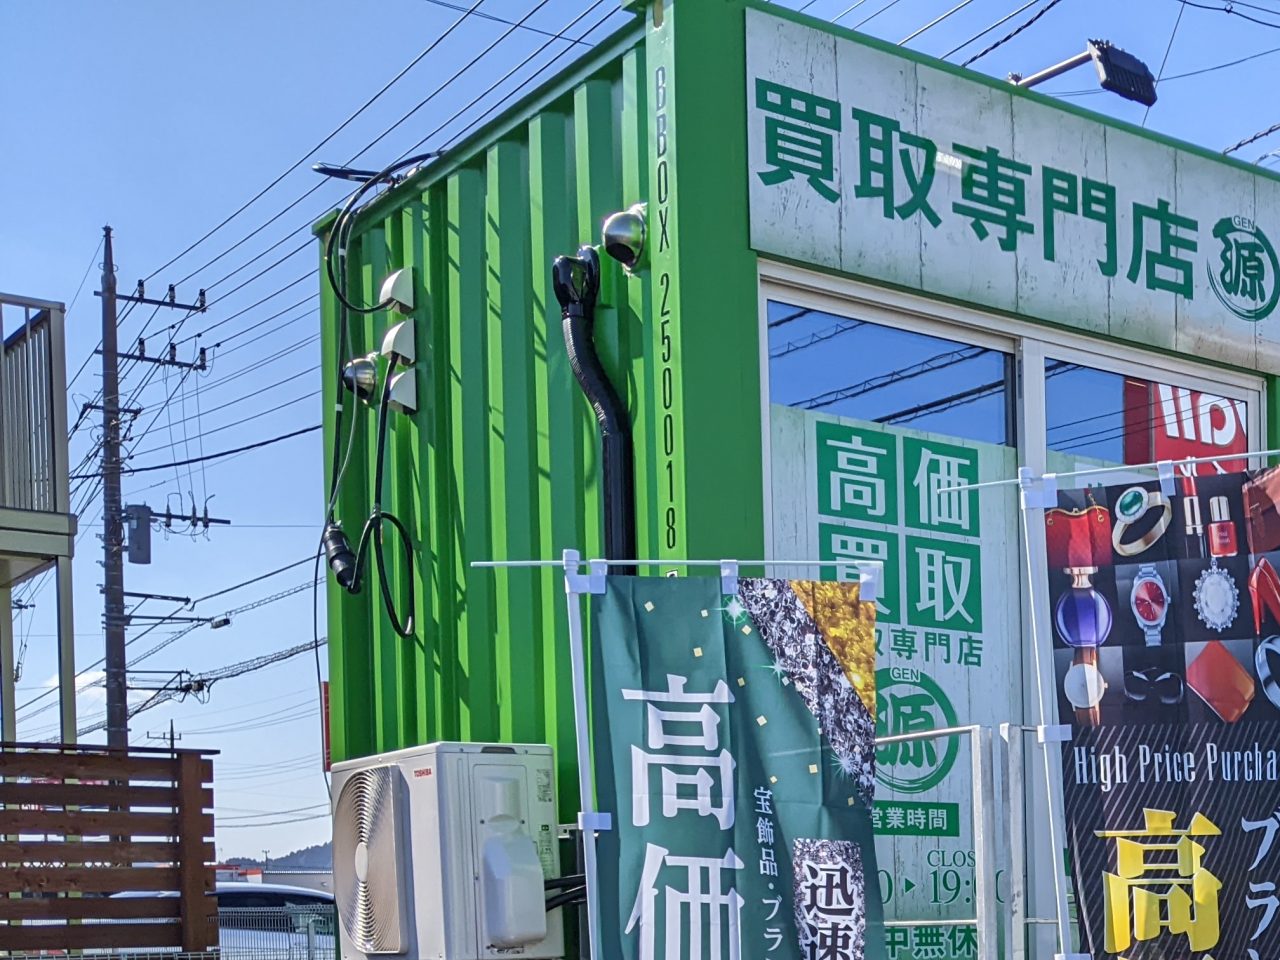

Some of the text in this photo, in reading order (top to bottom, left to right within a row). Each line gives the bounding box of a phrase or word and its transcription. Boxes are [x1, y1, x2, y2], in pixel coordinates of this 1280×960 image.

[654, 66, 671, 254] BBOX
[754, 78, 1266, 303] 買取専門店 源
[1232, 214, 1256, 230] GEN
[660, 272, 677, 549] 250018
[825, 434, 971, 531] 高価
[891, 666, 920, 682] GEN
[413, 767, 432, 778] TOSHIBA
[1073, 744, 1128, 793] High
[1138, 742, 1196, 784] Price
[871, 807, 948, 830] 営業時間
[926, 849, 976, 868] CLOS
[884, 925, 978, 960] 中無休
